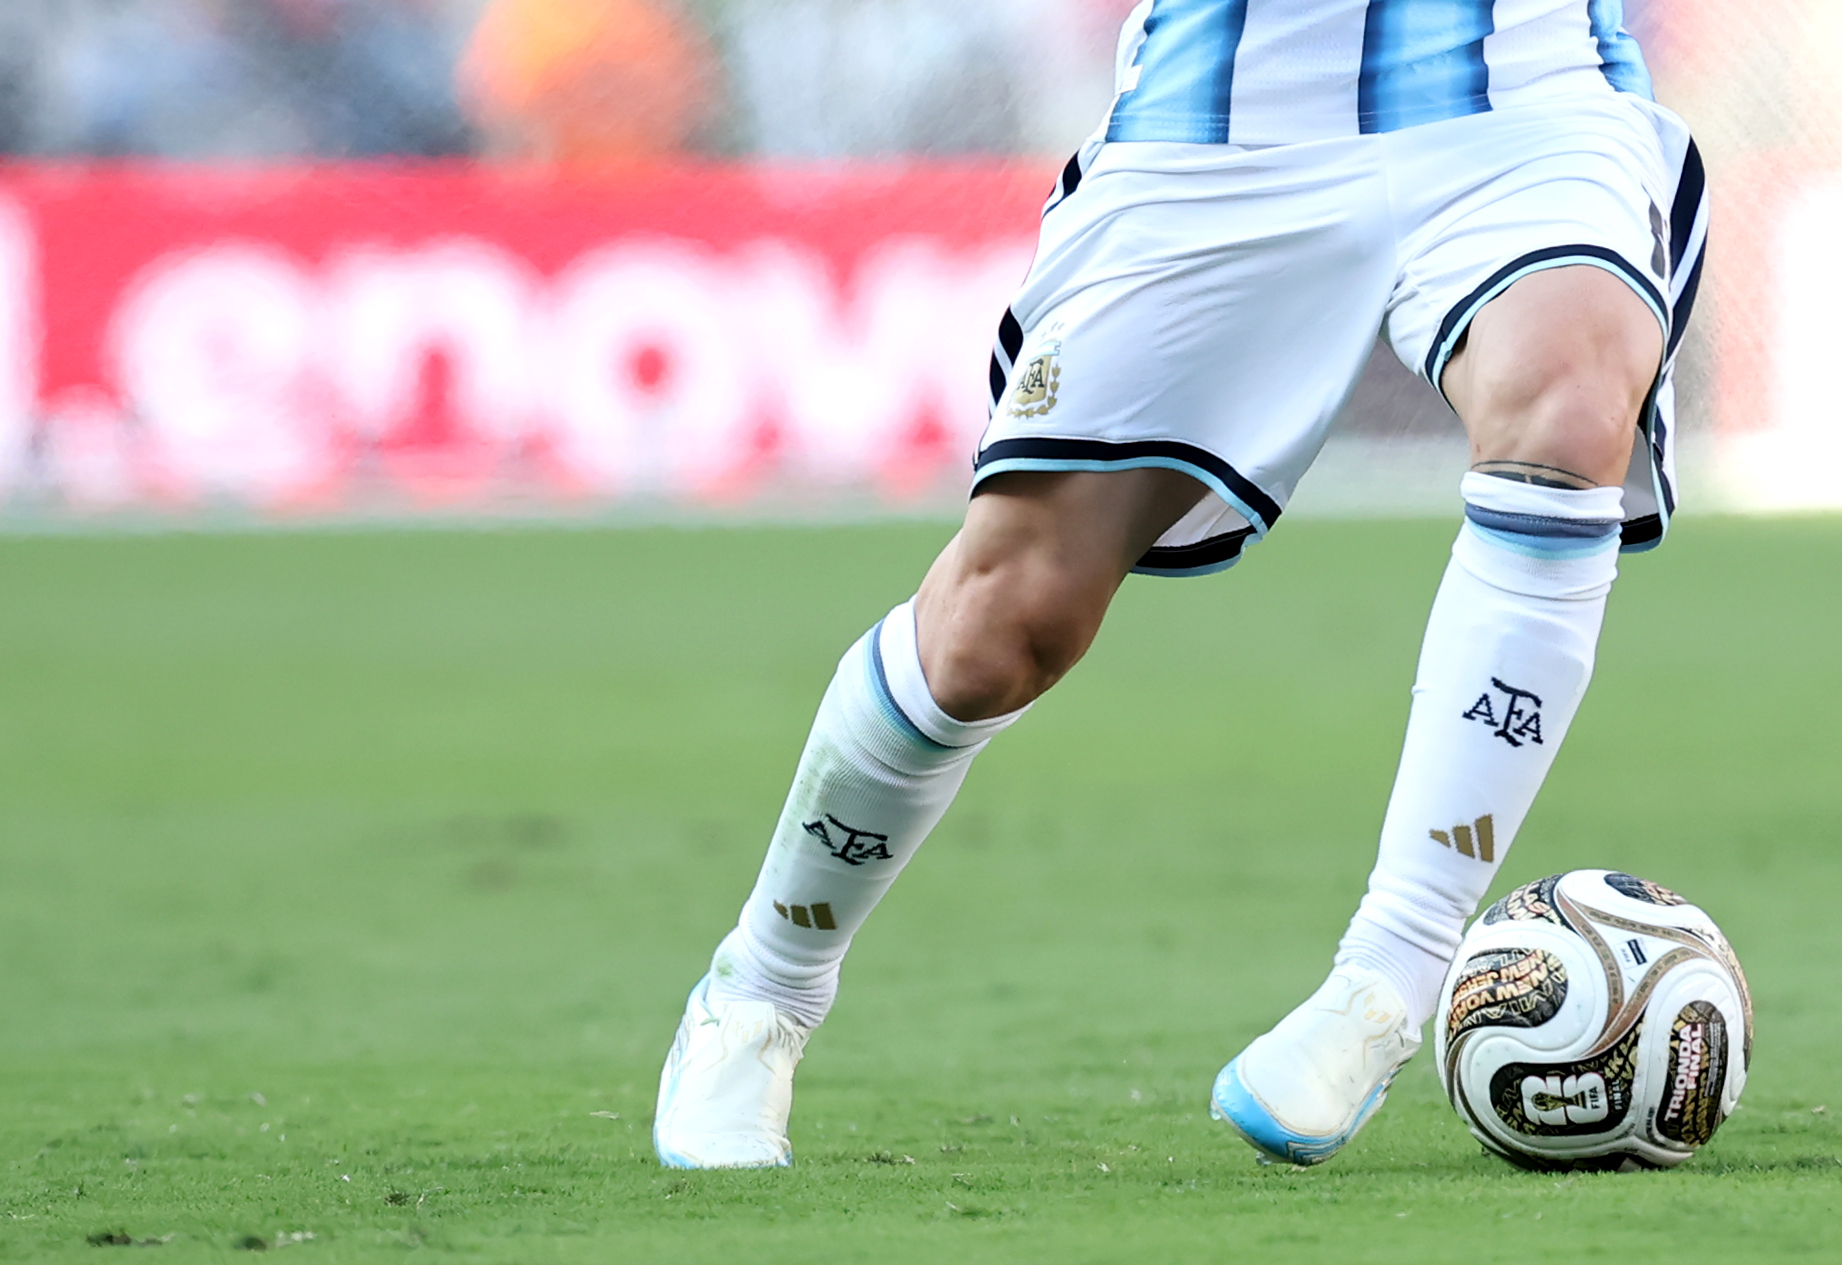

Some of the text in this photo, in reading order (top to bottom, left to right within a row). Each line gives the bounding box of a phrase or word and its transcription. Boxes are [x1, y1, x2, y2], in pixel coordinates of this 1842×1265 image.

[1462, 677, 1544, 747] AFA
[802, 813, 894, 865] AFA
[1496, 962, 1549, 1001] NEW
[1499, 948, 1545, 983] NEW
[1664, 1024, 1693, 1122] TRIONDA
[1686, 1023, 1703, 1090] FINAL
[1589, 1085, 1601, 1110] FIFA
[1611, 1078, 1623, 1111] FINAL
